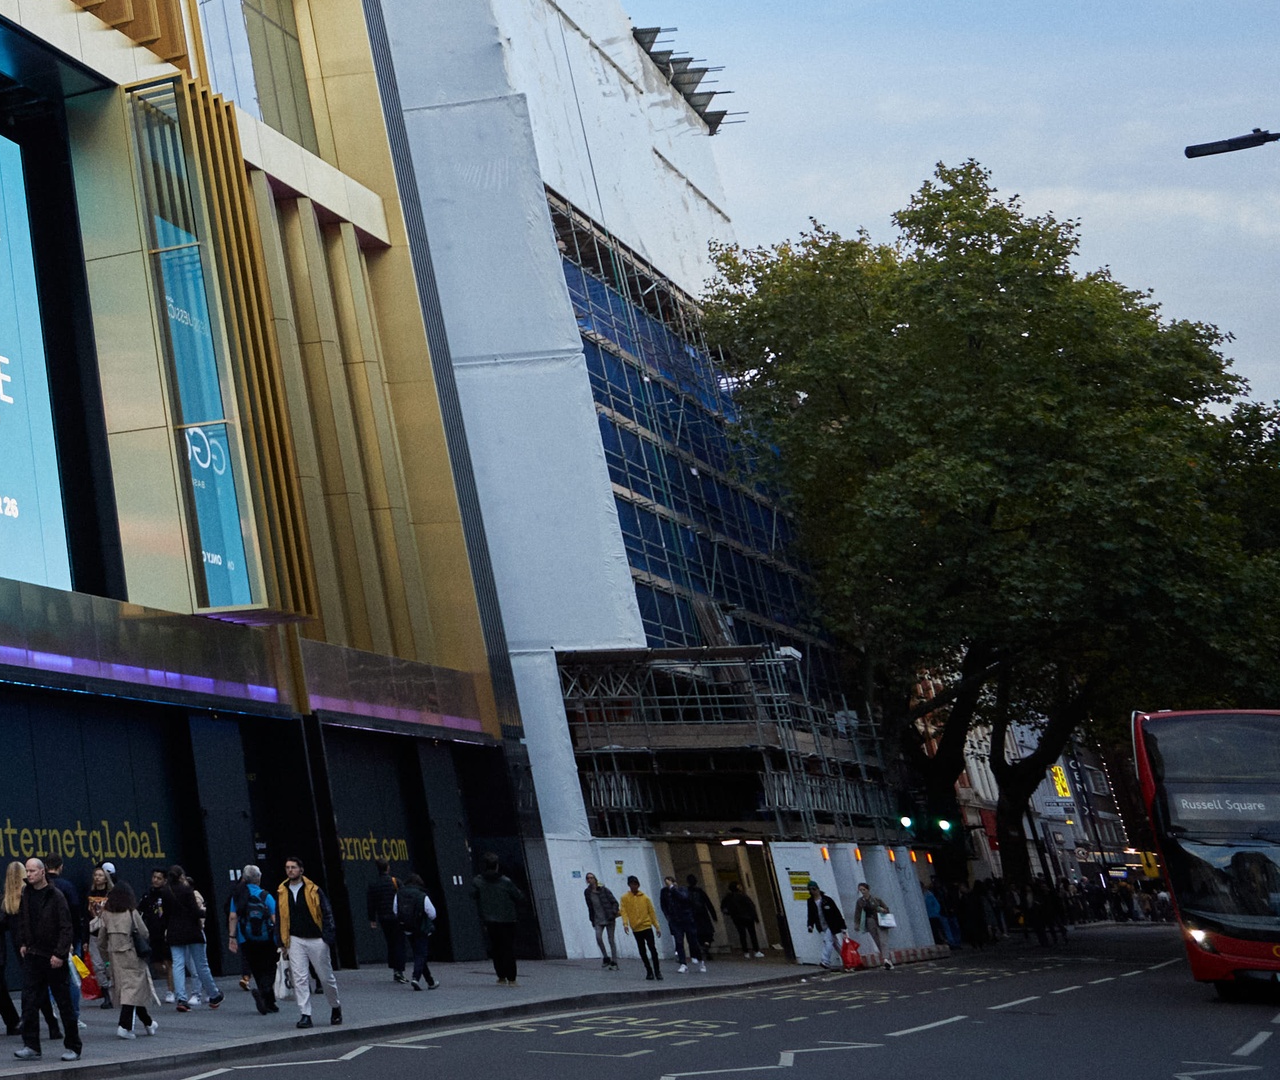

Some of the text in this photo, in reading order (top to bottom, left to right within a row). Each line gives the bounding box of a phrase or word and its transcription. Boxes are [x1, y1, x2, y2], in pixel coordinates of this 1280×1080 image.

[3, 497, 19, 518] 26
[1181, 798, 1266, 813] Russell Square
[489, 1022, 715, 1039] STOP
[571, 1016, 739, 1029] BUS
